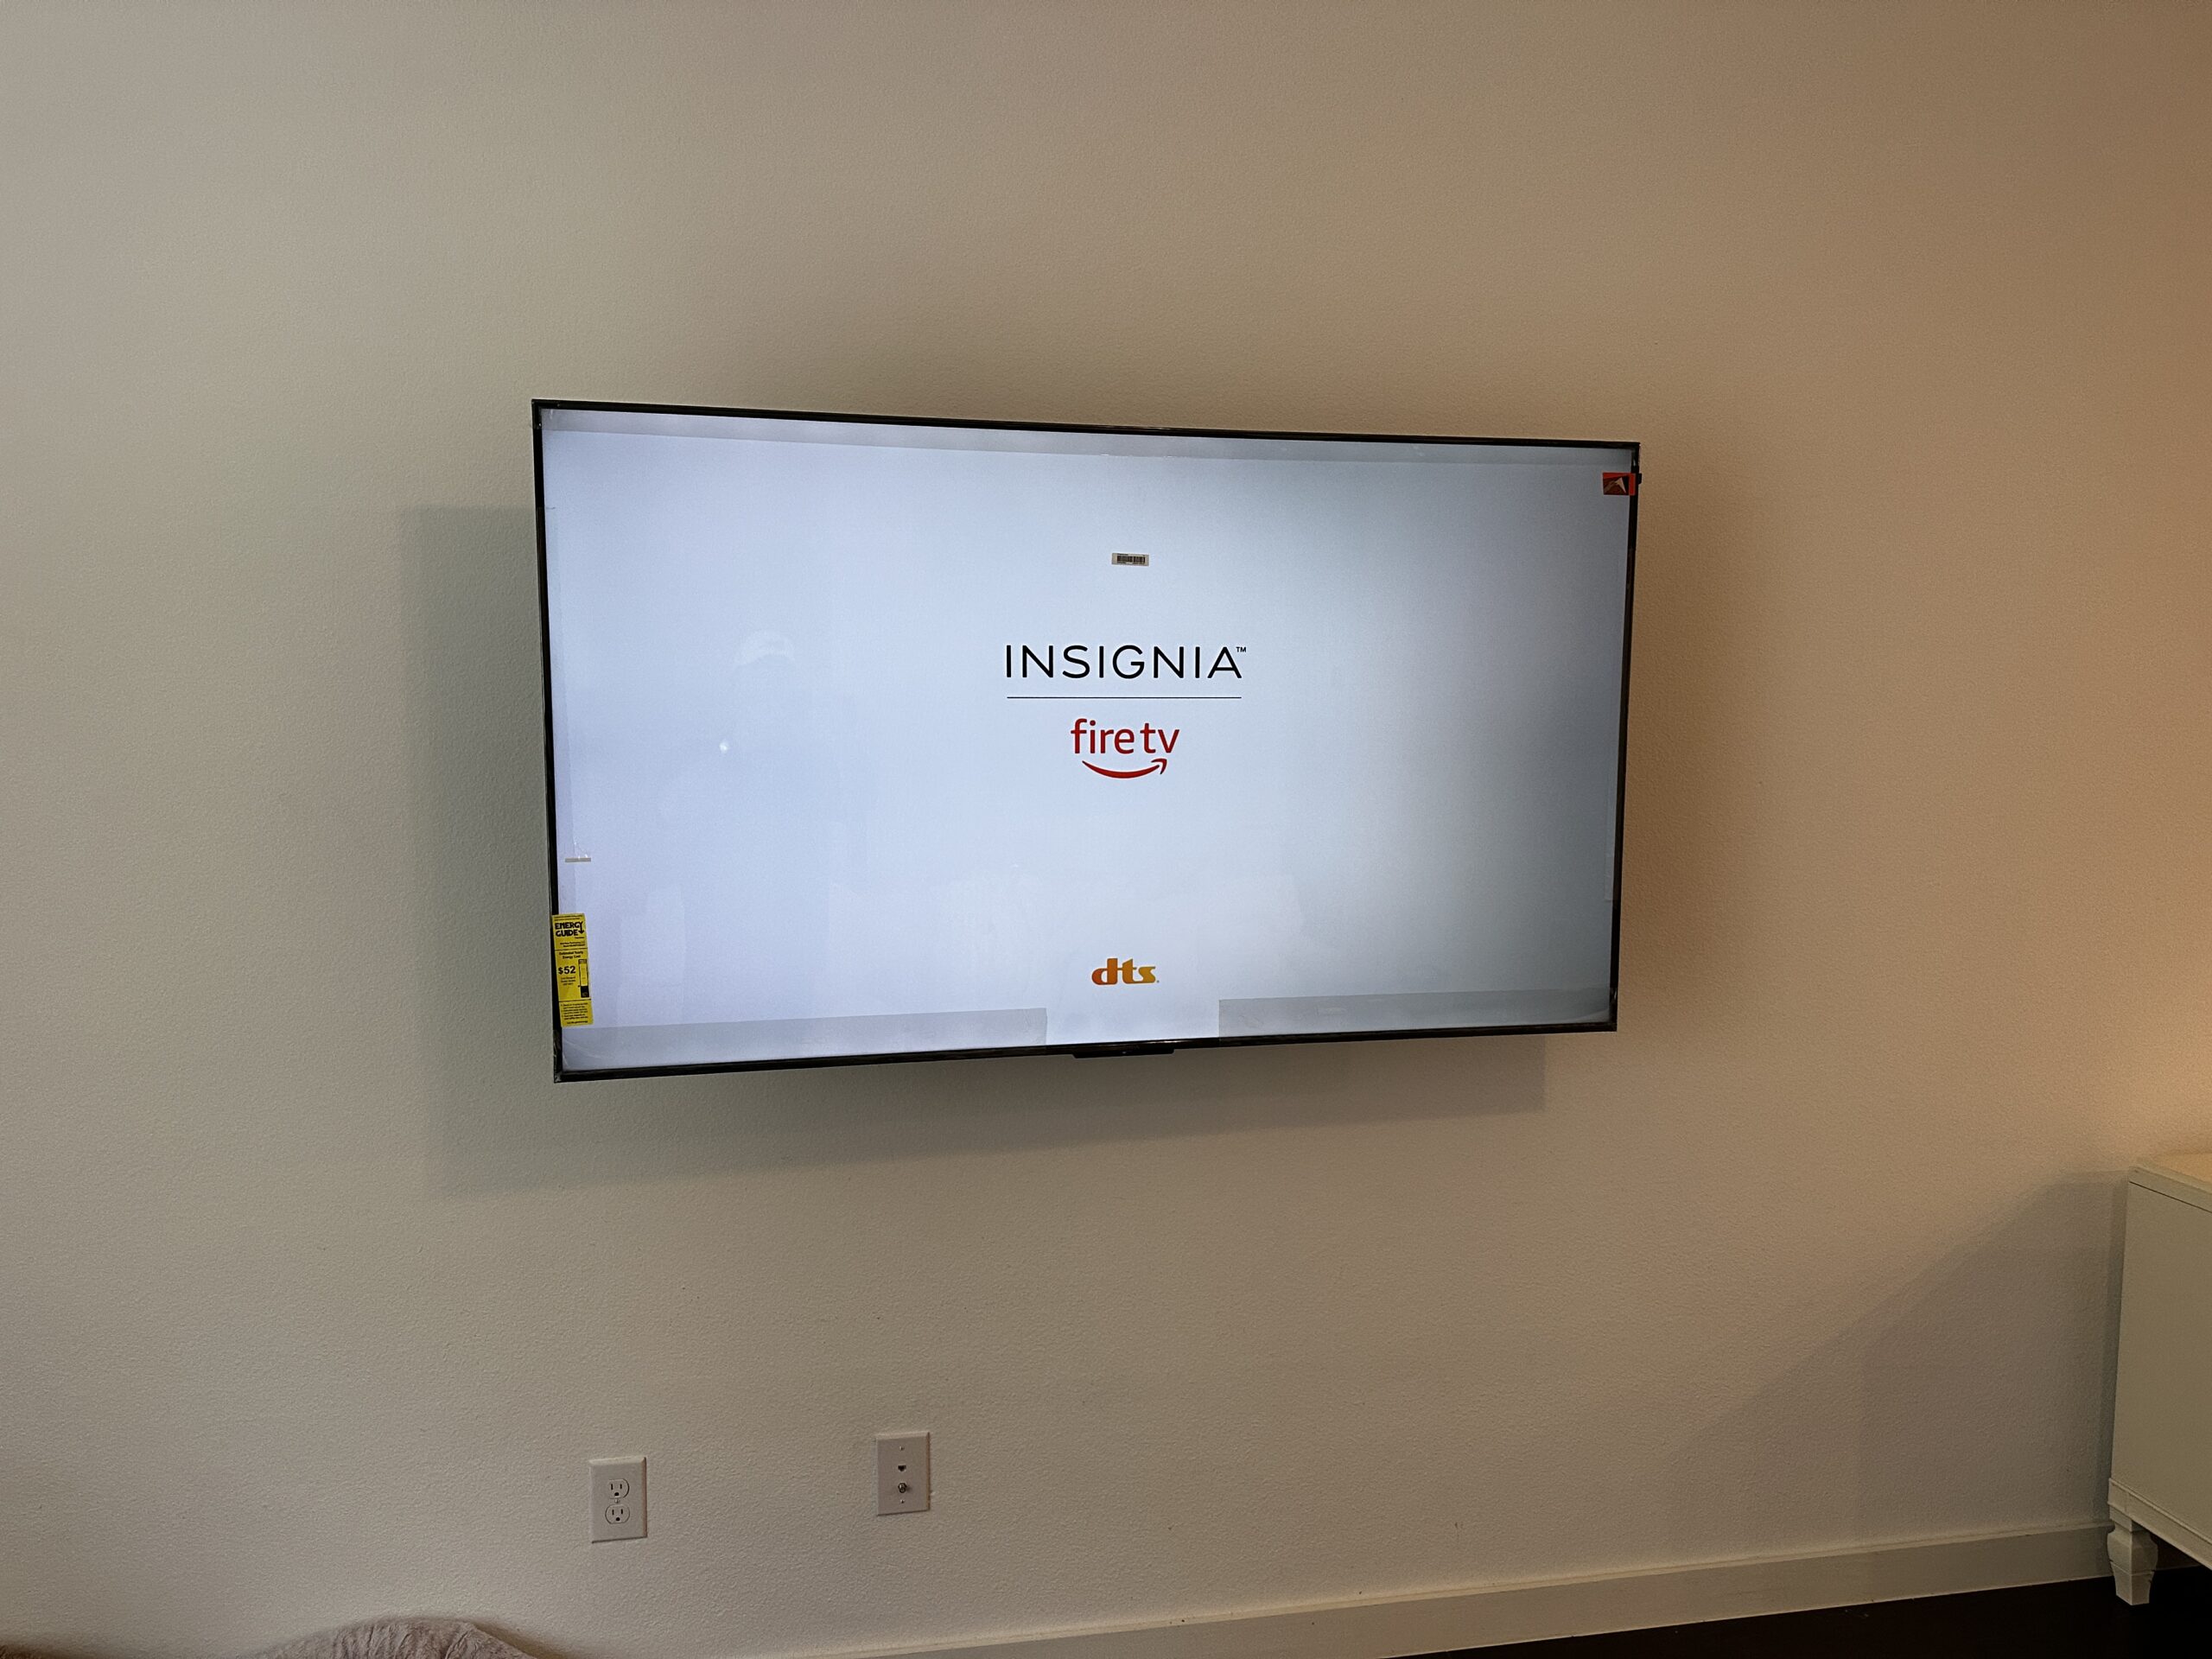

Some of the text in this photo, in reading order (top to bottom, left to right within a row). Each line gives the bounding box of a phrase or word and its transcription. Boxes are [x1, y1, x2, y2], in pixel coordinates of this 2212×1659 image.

[555, 921, 583, 930] ENERGY
[556, 929, 579, 938] GUIDE
[558, 965, 576, 975] $52
